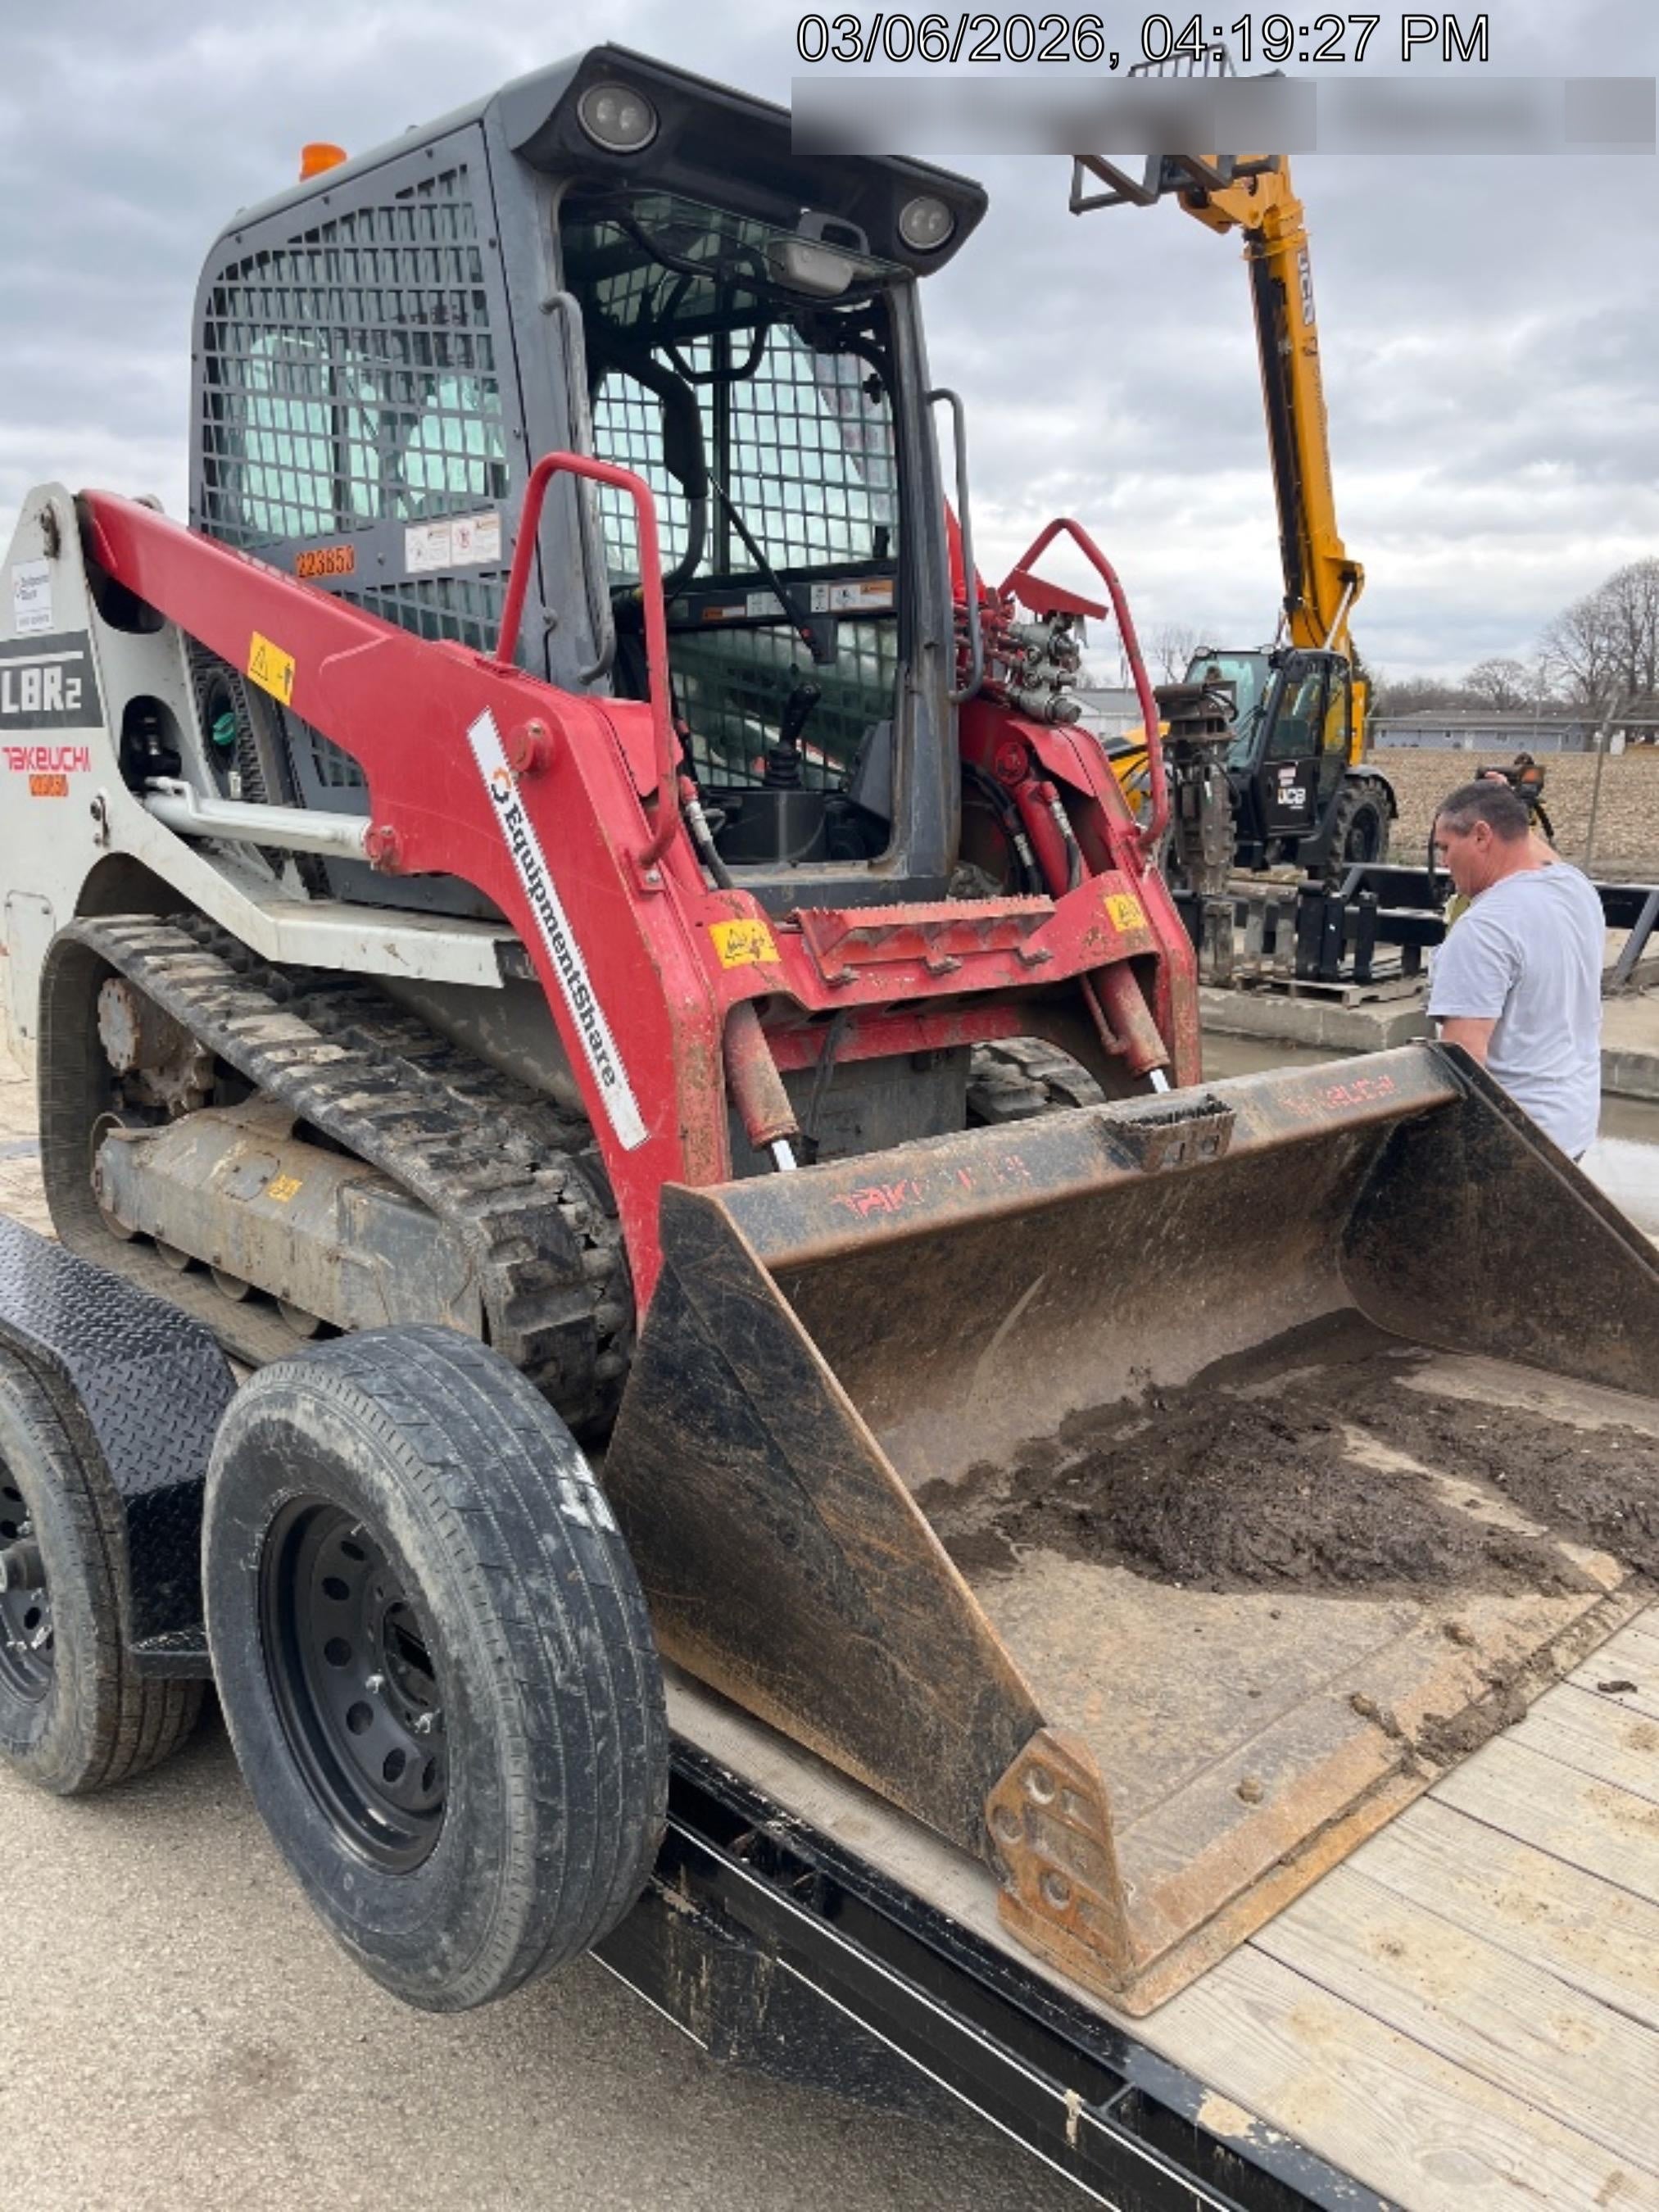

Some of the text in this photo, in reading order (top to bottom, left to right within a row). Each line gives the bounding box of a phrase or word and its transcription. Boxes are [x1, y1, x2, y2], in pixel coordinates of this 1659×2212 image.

[2, 746, 91, 772] TAKEUCHI
[1277, 787, 1306, 805] JCB
[502, 803, 617, 1088] EquipmentShare
